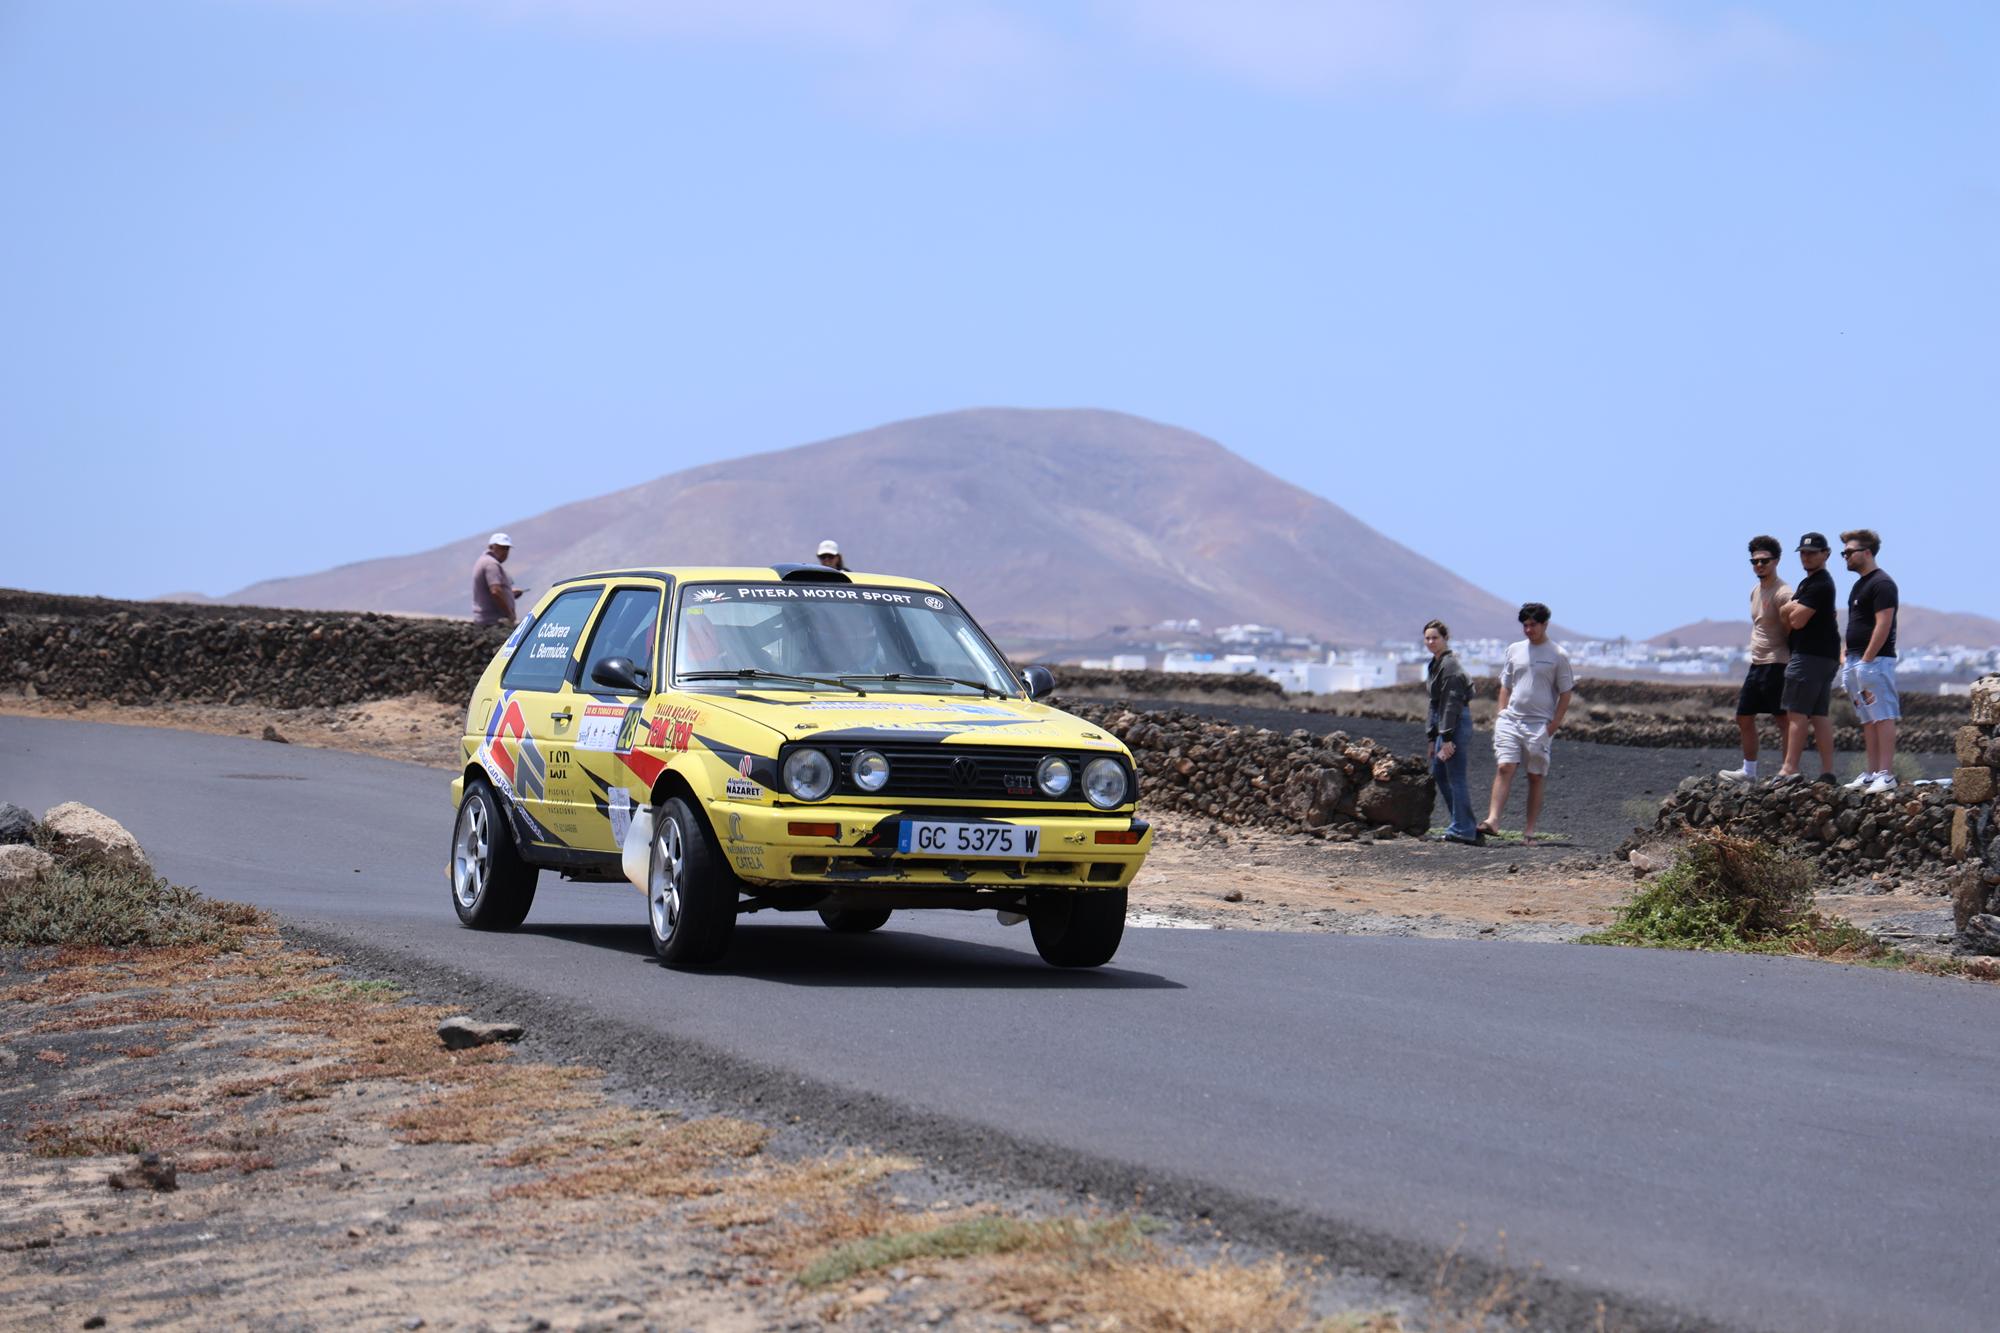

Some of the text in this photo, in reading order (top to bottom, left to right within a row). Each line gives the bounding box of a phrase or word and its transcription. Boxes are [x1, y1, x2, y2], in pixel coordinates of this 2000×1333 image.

[737, 588, 912, 604] PITERA MOTOR SPORT
[538, 622, 571, 638] C.Cabrera
[536, 642, 570, 659] Bermúdez
[616, 710, 640, 749] 28
[1003, 774, 1033, 789] GTI
[726, 785, 761, 796] NAZARET
[918, 826, 1038, 853] GC 5375 W
[736, 856, 765, 870] CATELA
